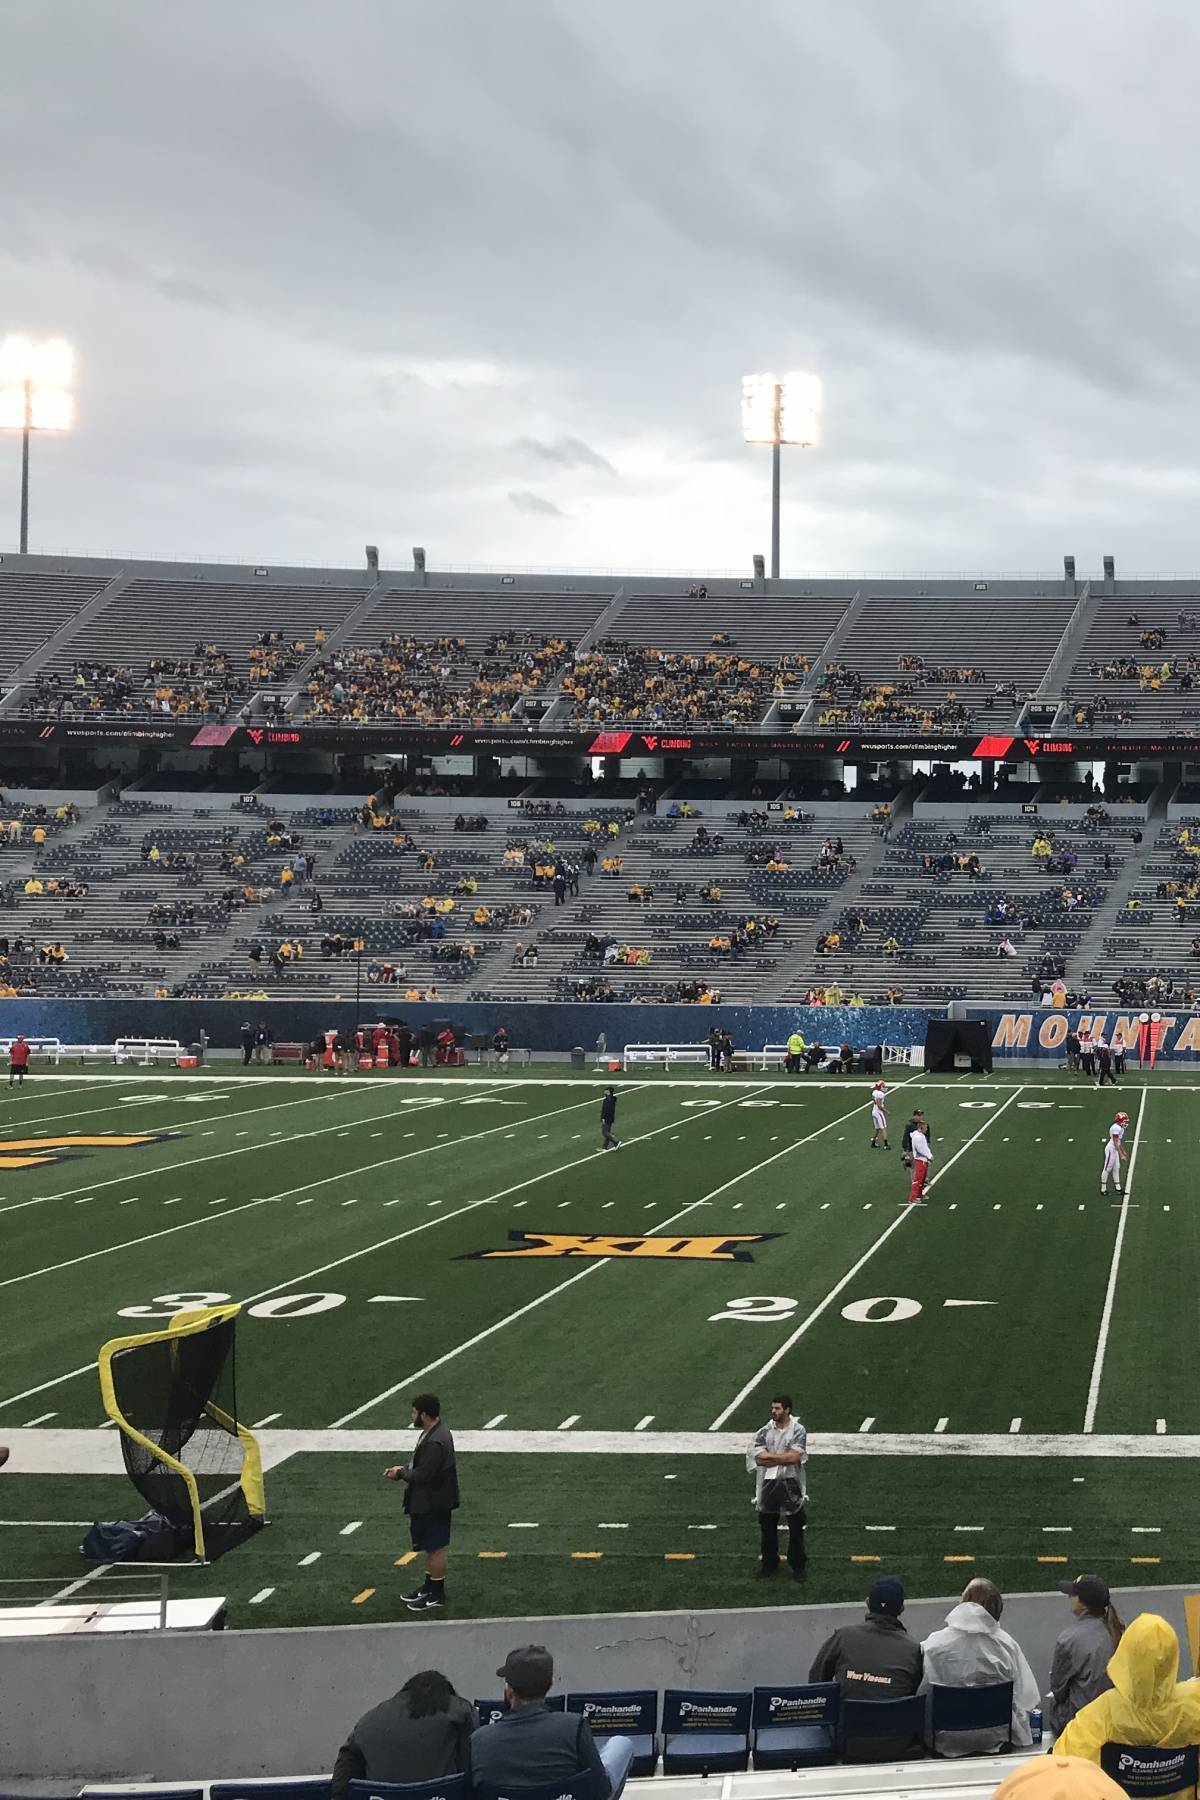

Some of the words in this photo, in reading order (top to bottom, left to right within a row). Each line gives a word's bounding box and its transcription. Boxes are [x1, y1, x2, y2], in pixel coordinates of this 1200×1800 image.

[117, 1292, 347, 1318] 30
[708, 1296, 923, 1323] 20
[781, 1696, 826, 1706] Panhandle
[595, 1704, 642, 1713] Panhandle
[691, 1704, 738, 1713] Panhandle
[1132, 1753, 1186, 1769] Panhandle
